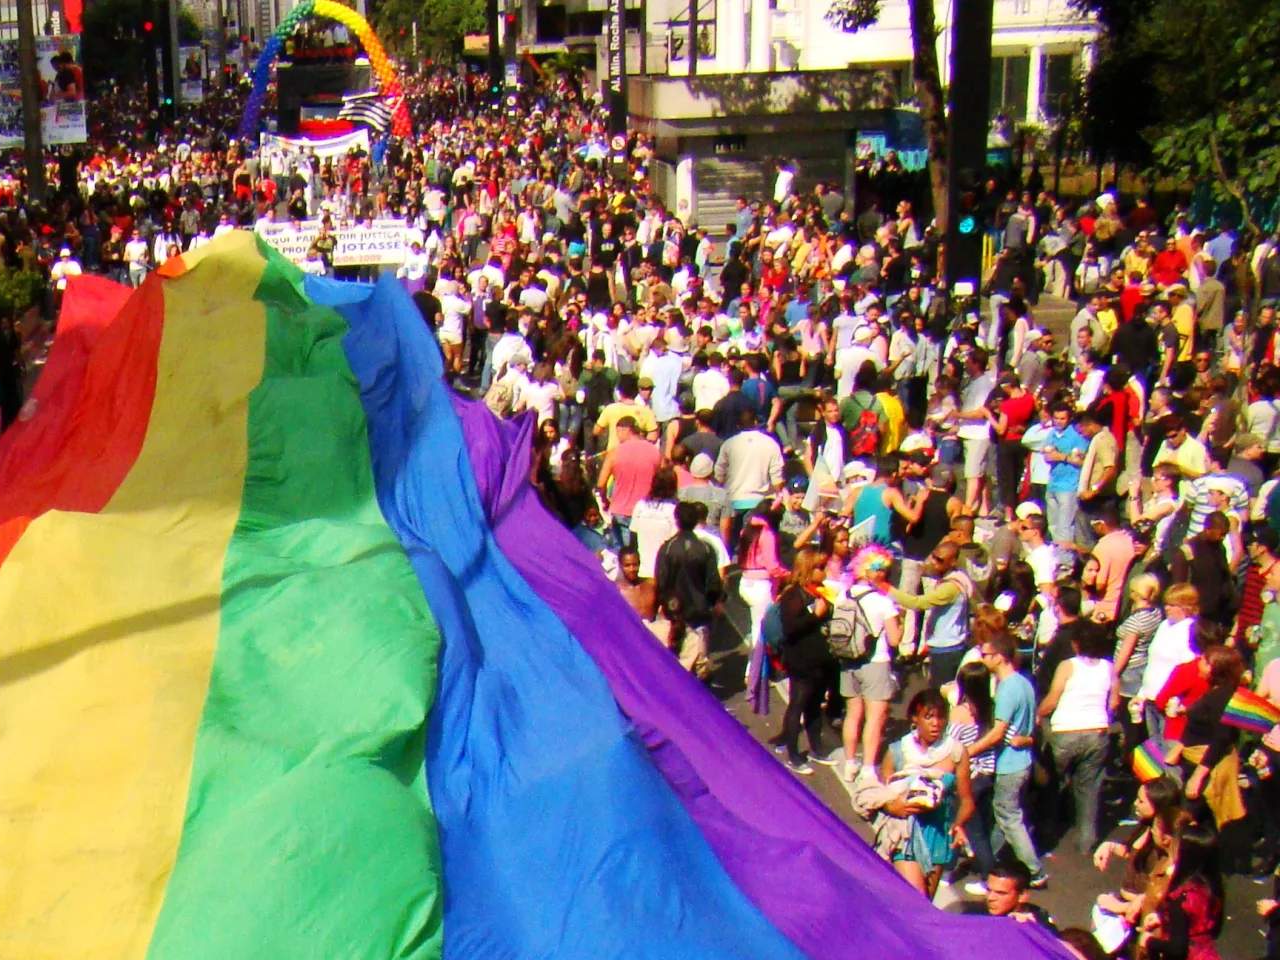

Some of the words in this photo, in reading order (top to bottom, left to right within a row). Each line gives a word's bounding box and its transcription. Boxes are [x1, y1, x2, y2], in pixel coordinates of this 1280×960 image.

[609, 0, 620, 13] Az
[609, 15, 620, 51] Rocha
[610, 52, 621, 76] Min.
